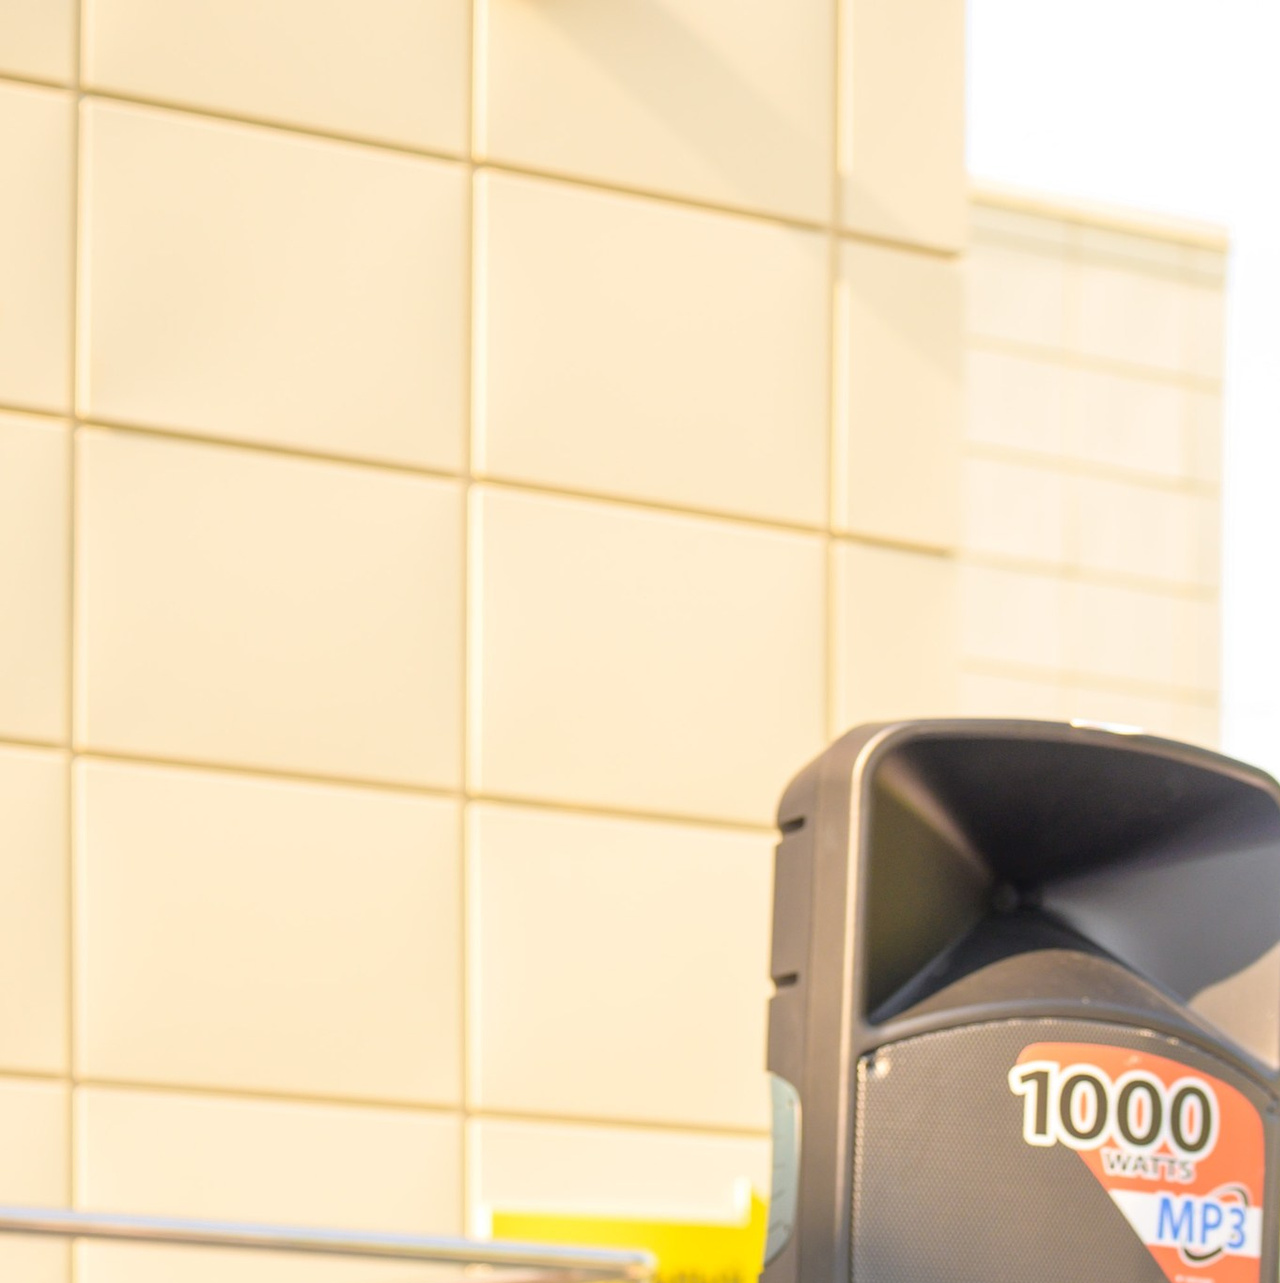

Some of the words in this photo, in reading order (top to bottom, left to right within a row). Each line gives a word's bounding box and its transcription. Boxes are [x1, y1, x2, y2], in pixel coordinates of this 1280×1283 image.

[1018, 1068, 1213, 1155] 1000
[1104, 1151, 1195, 1181] WATTS
[1156, 1196, 1247, 1250] MP3
